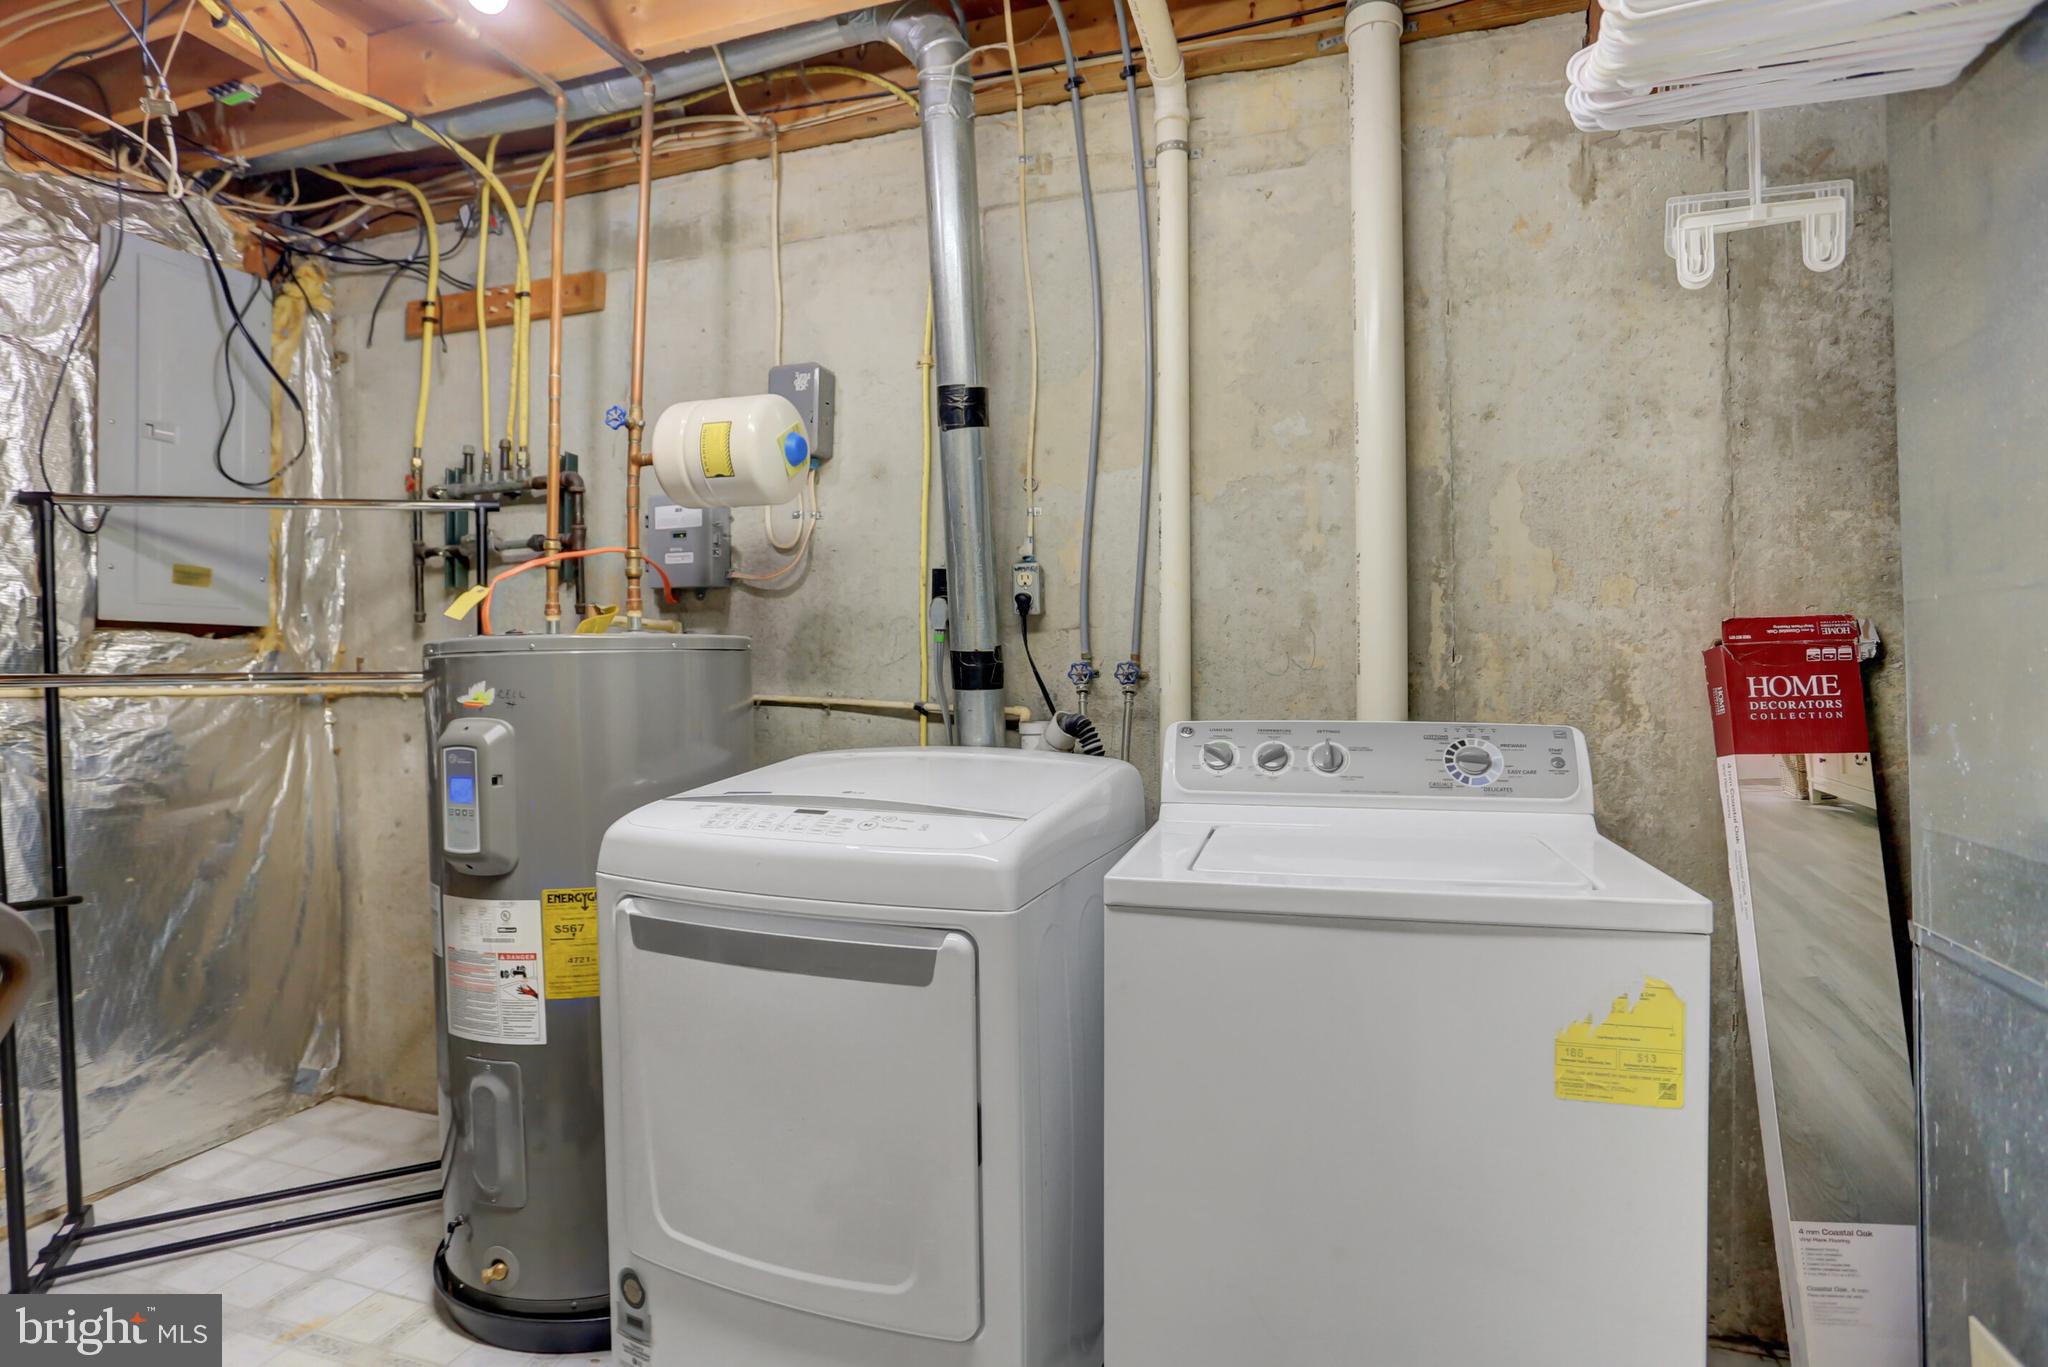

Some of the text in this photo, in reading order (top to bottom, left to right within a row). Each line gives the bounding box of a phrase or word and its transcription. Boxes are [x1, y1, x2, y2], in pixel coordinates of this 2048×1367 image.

[1822, 627, 1850, 635] HOME
[1746, 674, 1841, 698] HOME
[1750, 700, 1843, 710] DECORATORS
[1750, 711, 1844, 720] COLLECTION
[1821, 1228, 1854, 1237] Coastal
[1856, 1229, 1873, 1237] Oak
